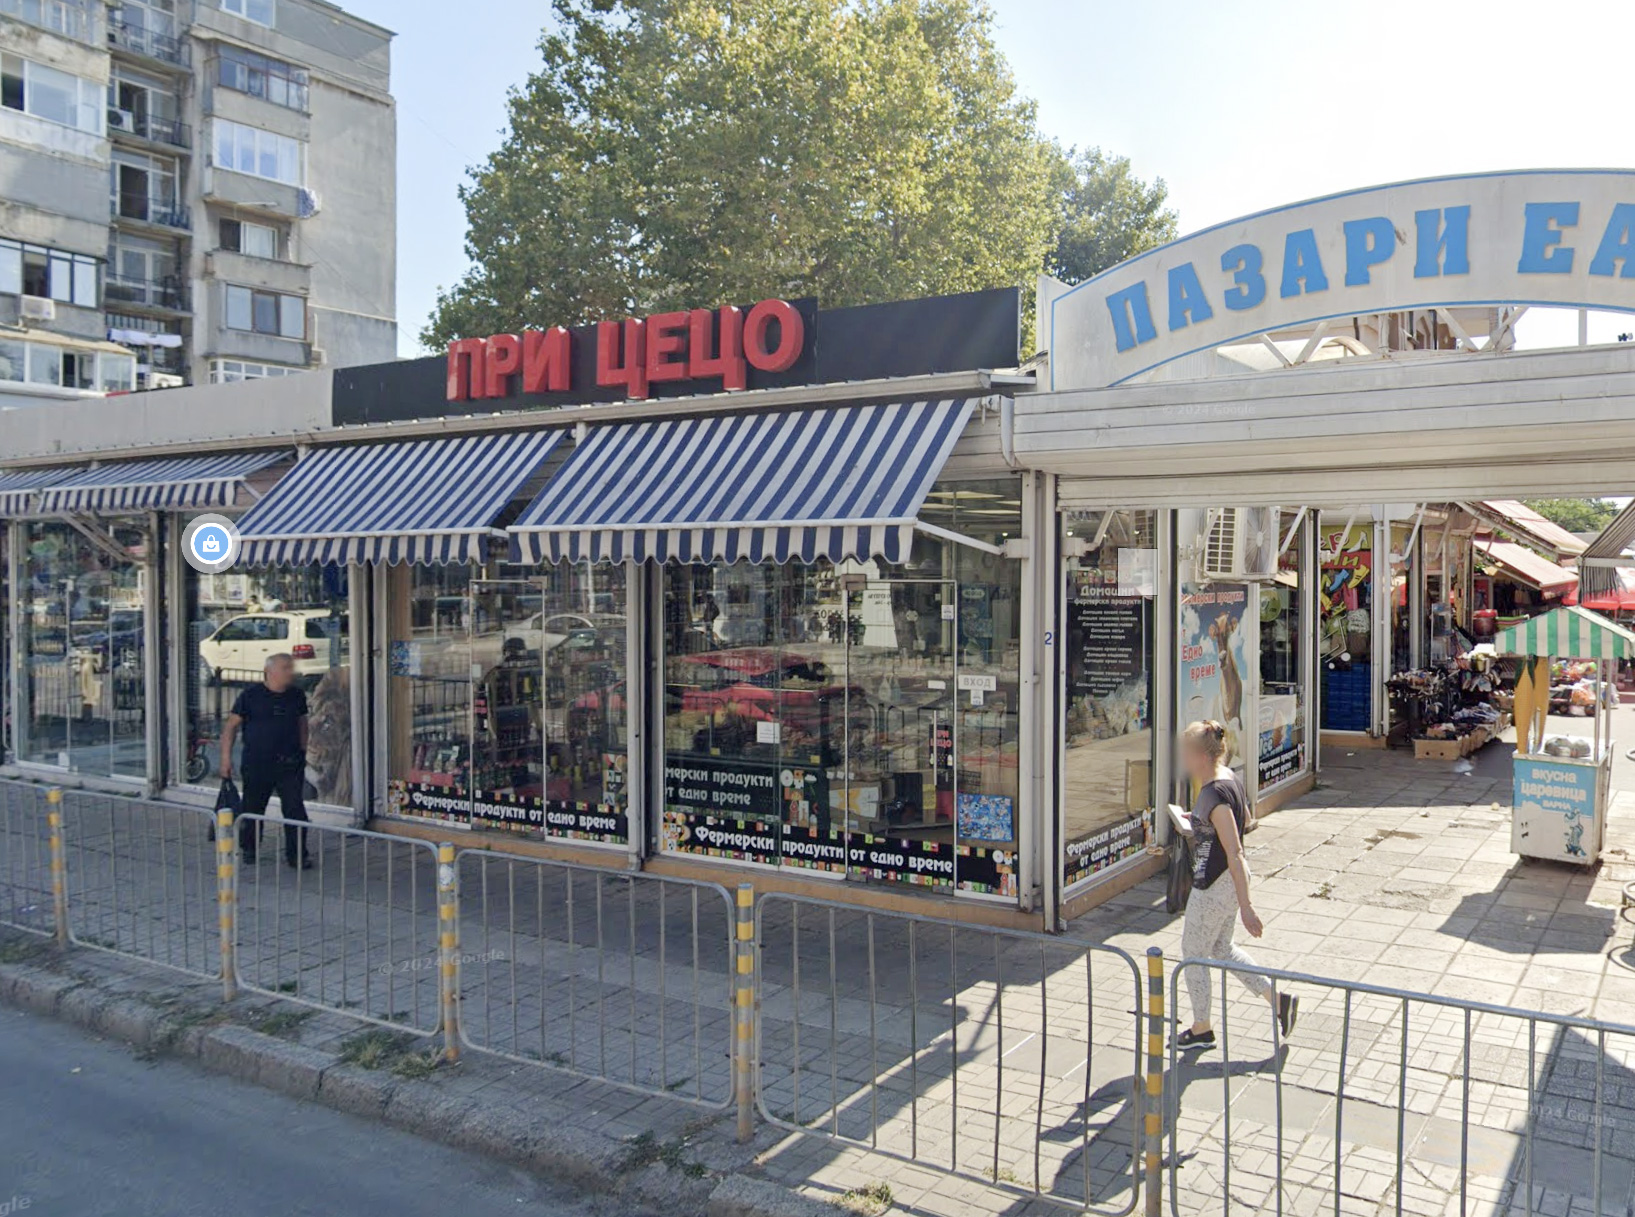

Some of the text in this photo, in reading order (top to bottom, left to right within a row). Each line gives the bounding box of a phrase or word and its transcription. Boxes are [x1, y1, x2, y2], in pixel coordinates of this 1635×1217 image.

[1105, 205, 1470, 354] ПАЗАРИ
[447, 299, 804, 400] ПРИ ЦЕЦО
[1045, 632, 1053, 645] 2
[963, 675, 991, 688] ВХОД
[713, 771, 773, 788] продукти
[412, 791, 616, 831] Фермерски продукти от едно време
[678, 787, 708, 800] едно
[712, 791, 751, 806] време
[695, 825, 953, 874] Фермерски продукти от едно време
